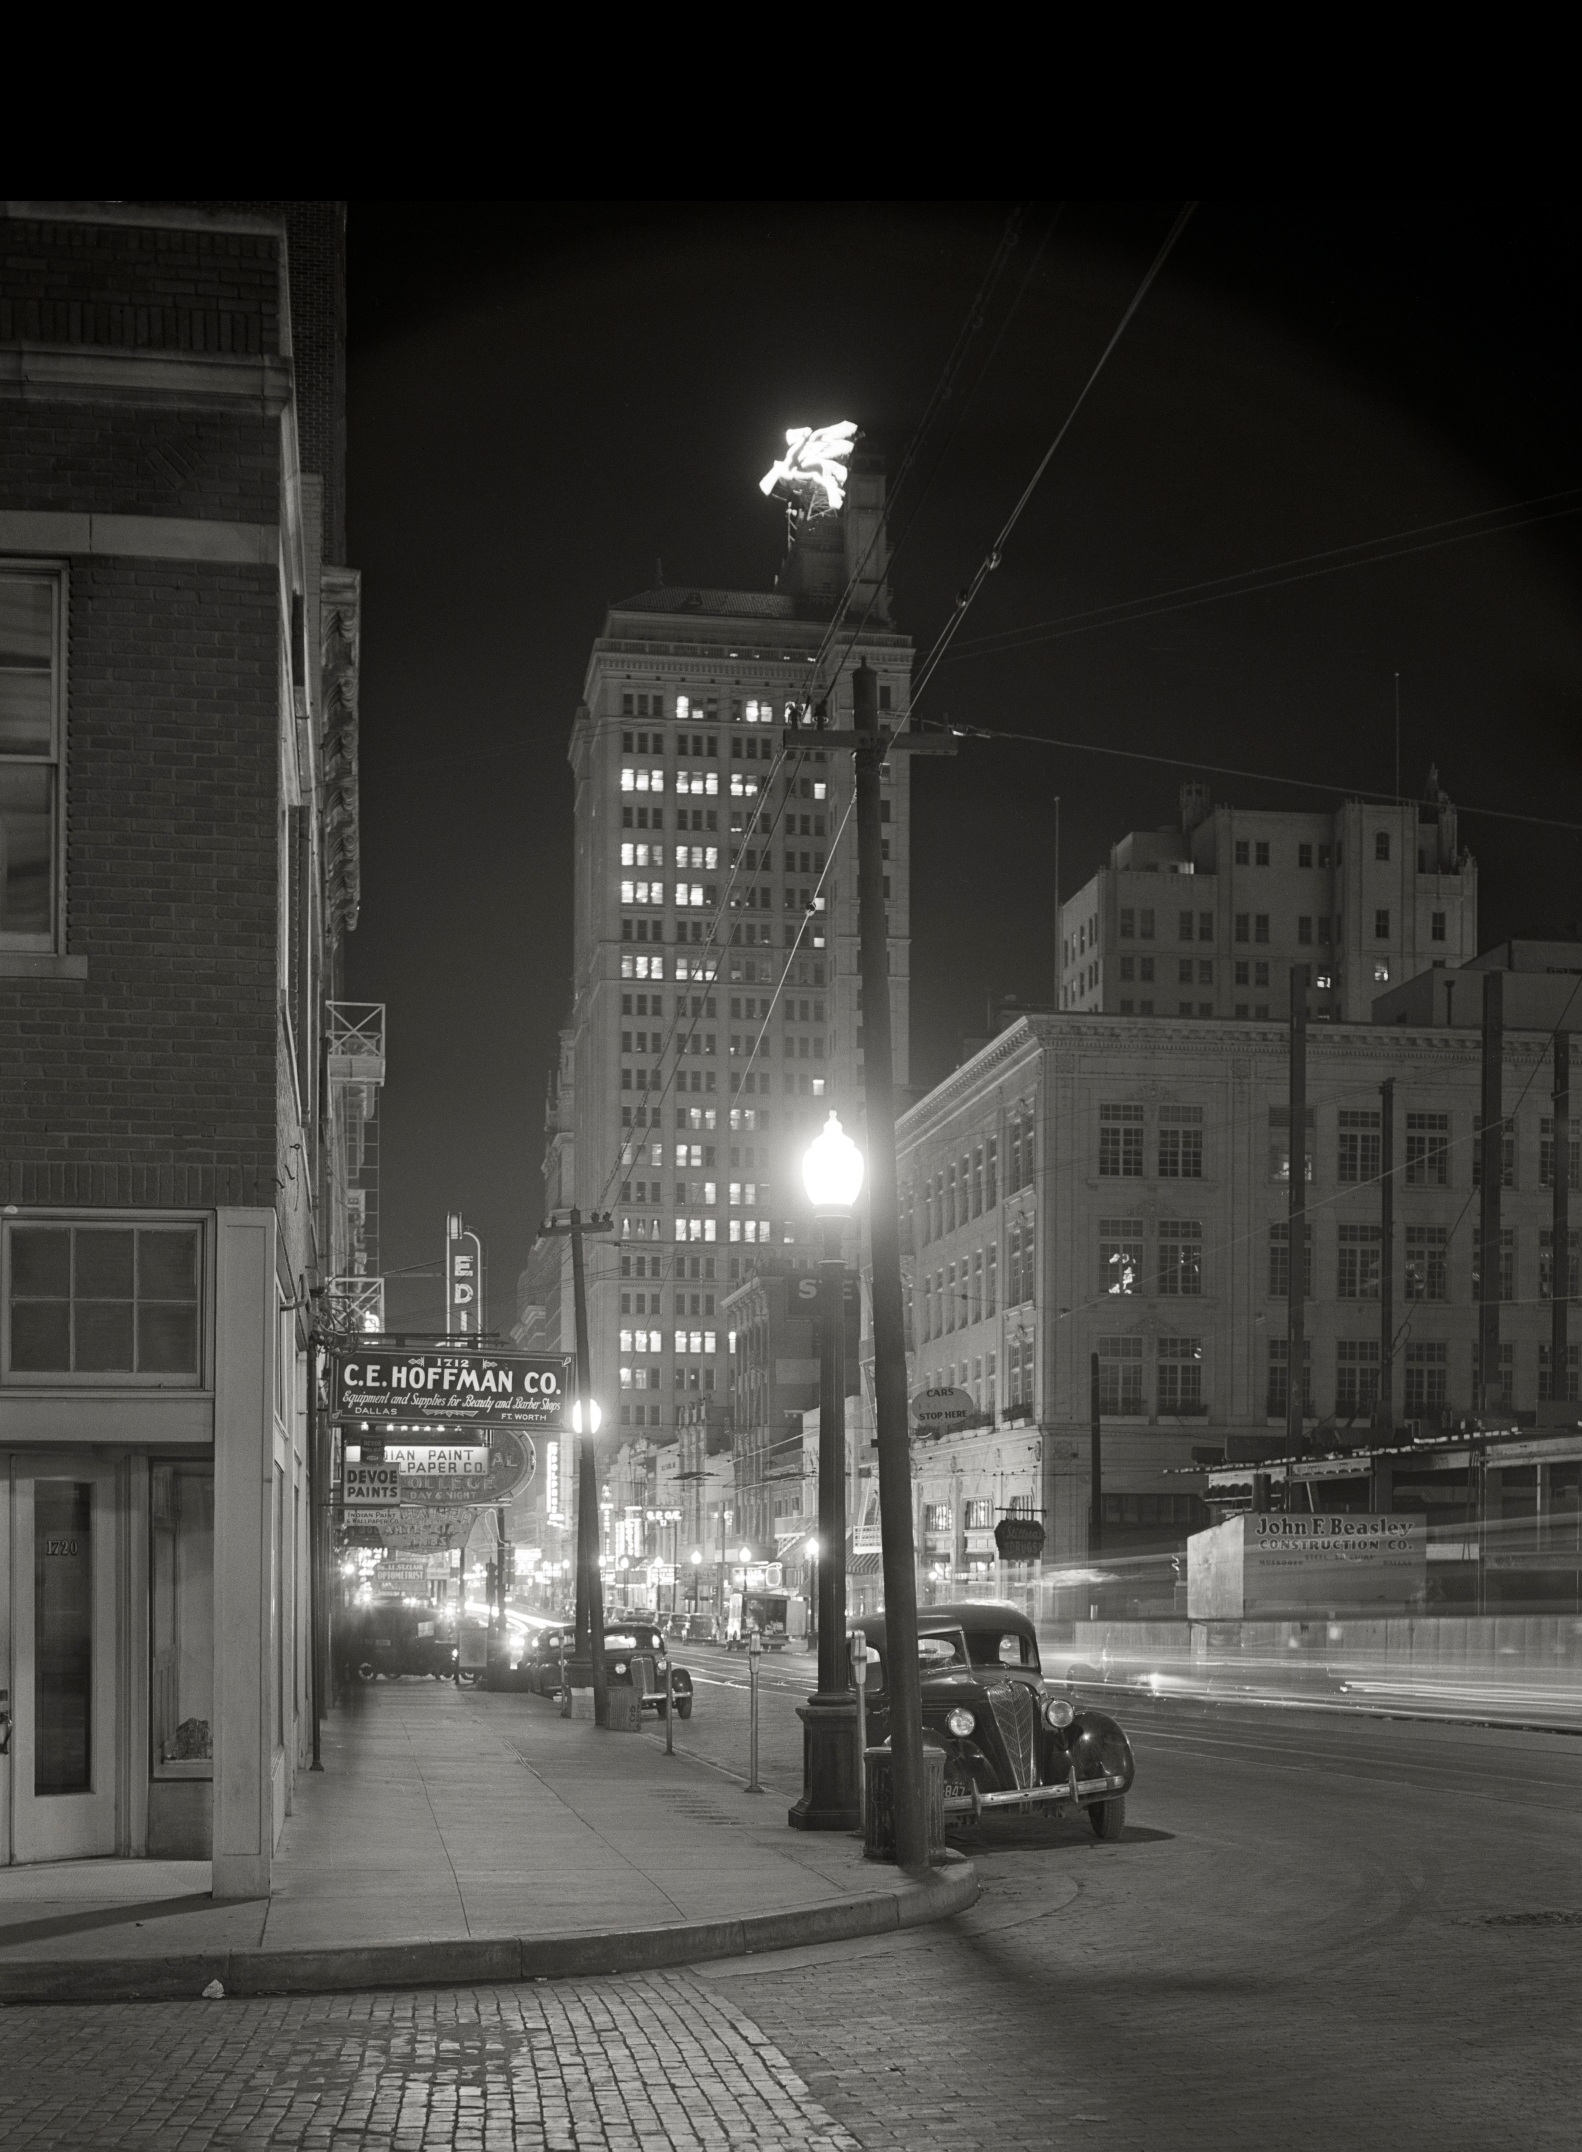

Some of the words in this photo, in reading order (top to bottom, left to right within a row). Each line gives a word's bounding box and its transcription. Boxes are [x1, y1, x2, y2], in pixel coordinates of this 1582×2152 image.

[436, 1358, 470, 1368] 1712
[344, 1364, 388, 1387] C.E.
[392, 1366, 514, 1393] HOFFMAN
[524, 1372, 561, 1395] CO.
[926, 1388, 954, 1398] CARS
[342, 1391, 390, 1409] Equipment
[390, 1393, 408, 1405] and
[411, 1393, 447, 1408] Supplies
[447, 1394, 461, 1408] for
[462, 1395, 495, 1412] Beauty
[495, 1396, 512, 1409] and
[512, 1397, 541, 1410] Barber
[541, 1397, 561, 1412] Shops
[355, 1407, 398, 1416] DALLAS
[501, 1413, 513, 1421] FT.
[515, 1413, 547, 1421] WORTH
[919, 1411, 943, 1421] STOP
[944, 1410, 968, 1419] HERE
[428, 1449, 474, 1461] PAINT
[399, 1462, 457, 1473] LPAPER
[463, 1462, 486, 1474] CO.
[347, 1469, 398, 1484] DEVOE
[407, 1475, 496, 1491] OLLEGE
[347, 1486, 398, 1498] PAINTS
[410, 1491, 433, 1500] DAY
[448, 1491, 477, 1500] NIGHT
[1256, 1517, 1308, 1536] John
[1311, 1517, 1325, 1536] F.
[1329, 1516, 1414, 1538] Beasley
[46, 1540, 79, 1556] 1720
[1010, 1541, 1038, 1555] DRUGS
[1259, 1539, 1380, 1551] CONSTRUCTION
[1387, 1539, 1413, 1551] CO.
[377, 1570, 424, 1580] OPTOMETRIST
